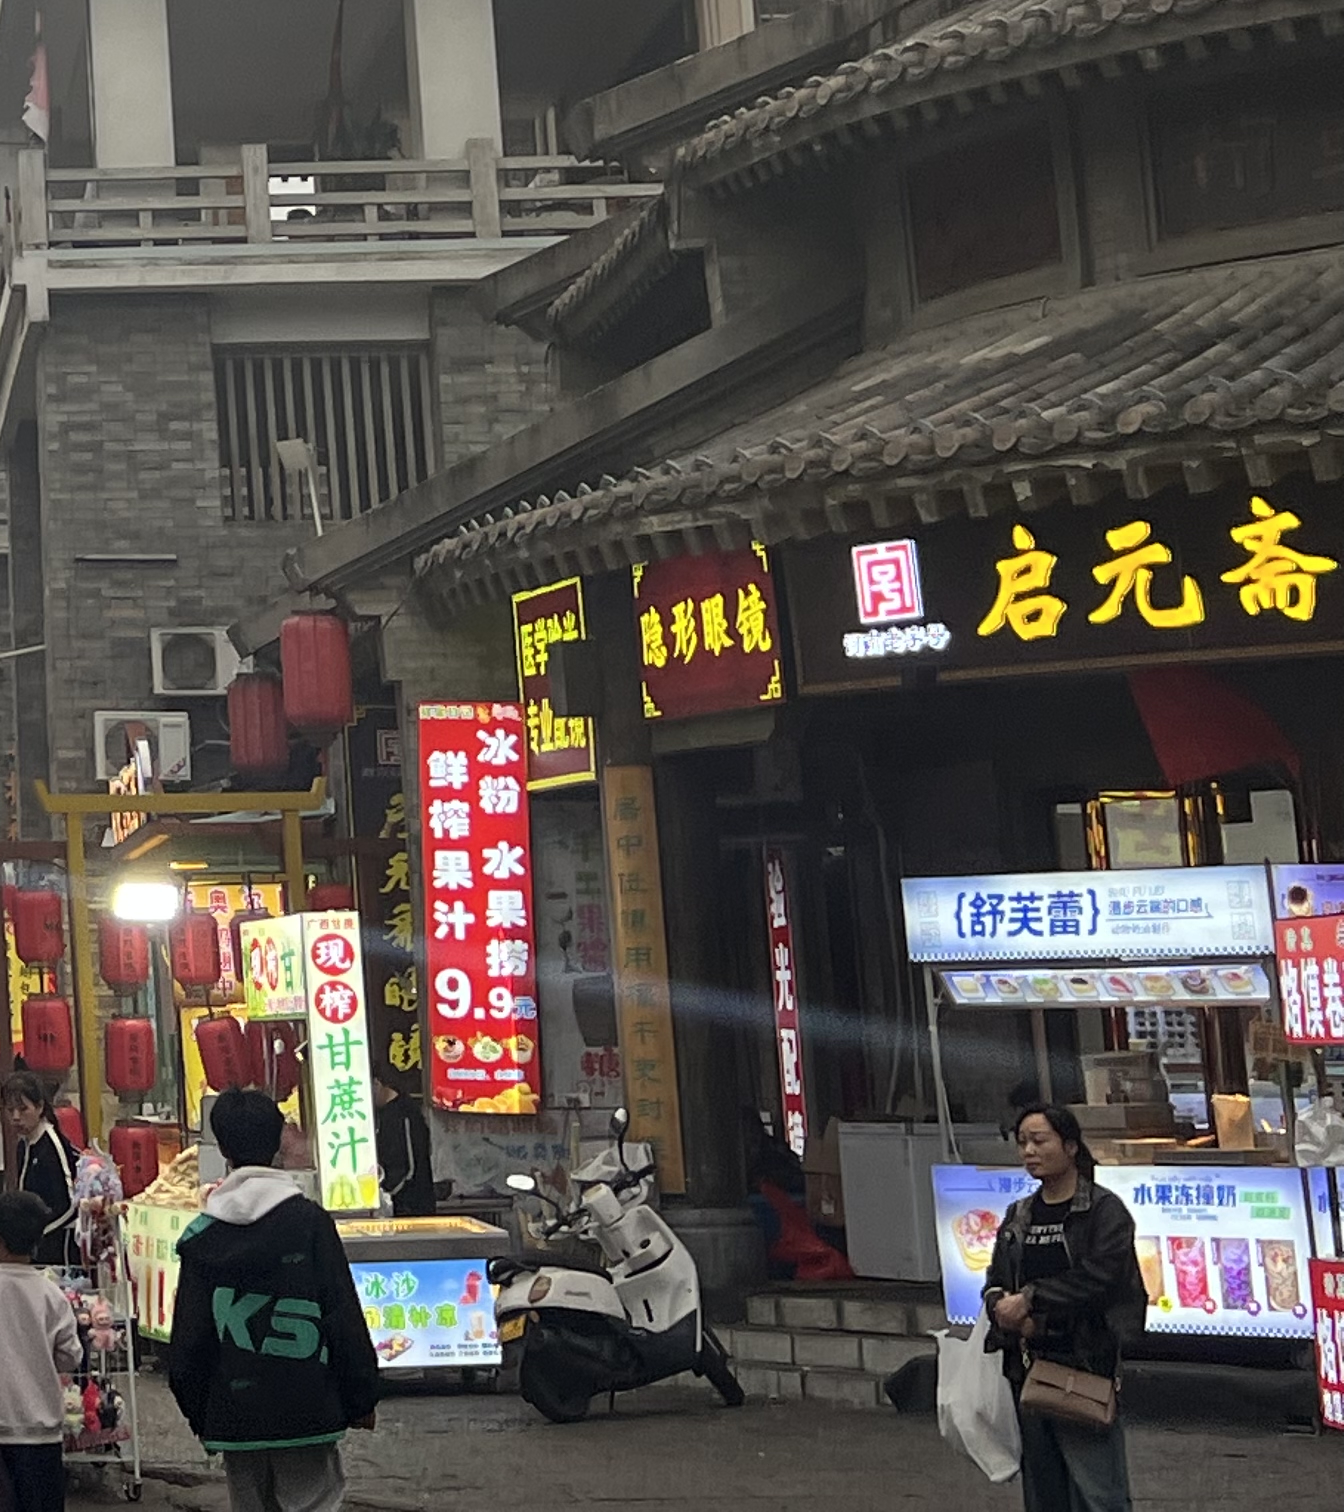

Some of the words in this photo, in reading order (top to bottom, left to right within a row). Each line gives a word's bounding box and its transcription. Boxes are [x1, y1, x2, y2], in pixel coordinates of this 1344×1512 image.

[977, 496, 1340, 642] 启元斋
[640, 583, 774, 670] 隐形眼镜
[475, 728, 521, 815] 冰粉
[426, 750, 476, 942] 鲜榨果汁
[481, 841, 530, 979] 水果捞
[312, 935, 370, 1176] 现榨甘蔗汁
[1133, 1183, 1237, 1207] 水果冻撞奶
[363, 1270, 420, 1299] 冰沙
